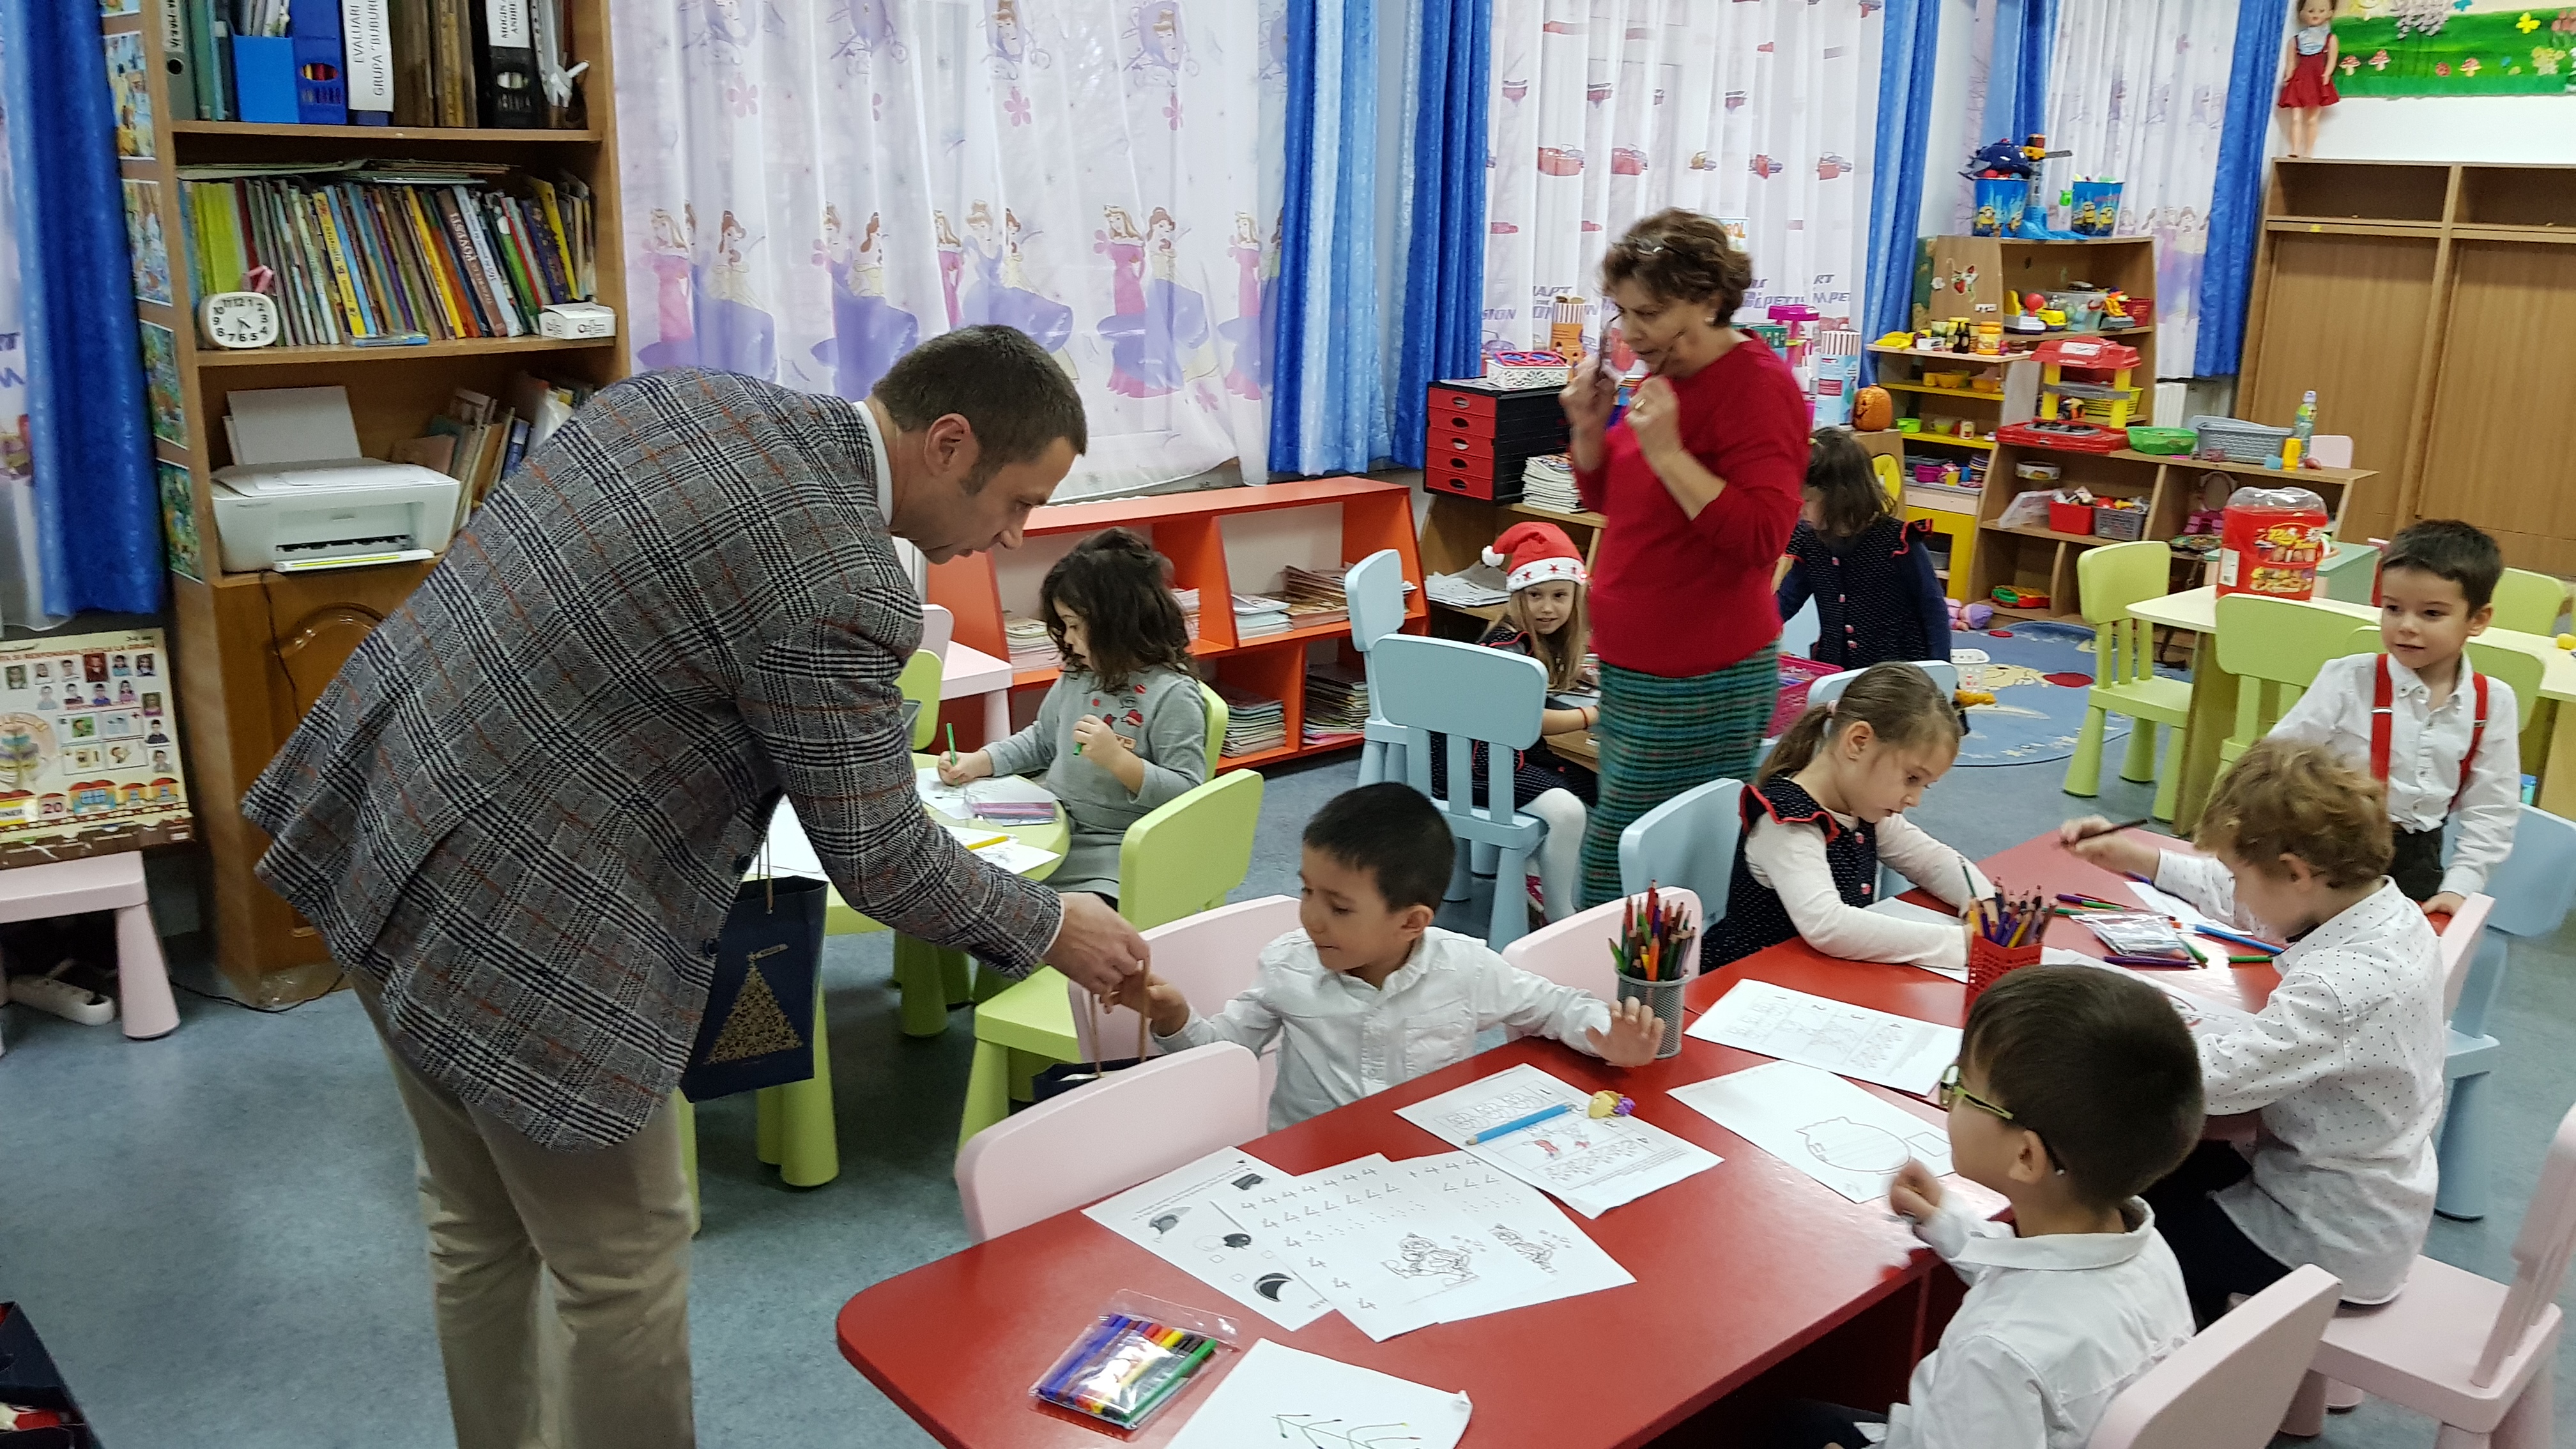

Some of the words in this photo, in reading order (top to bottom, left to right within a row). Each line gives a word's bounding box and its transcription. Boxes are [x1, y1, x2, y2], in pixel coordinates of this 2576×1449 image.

[349, 4, 364, 63] EVALUARI
[372, 55, 385, 96] GRUPA
[233, 298, 245, 307] 12
[42, 802, 63, 814] 20
